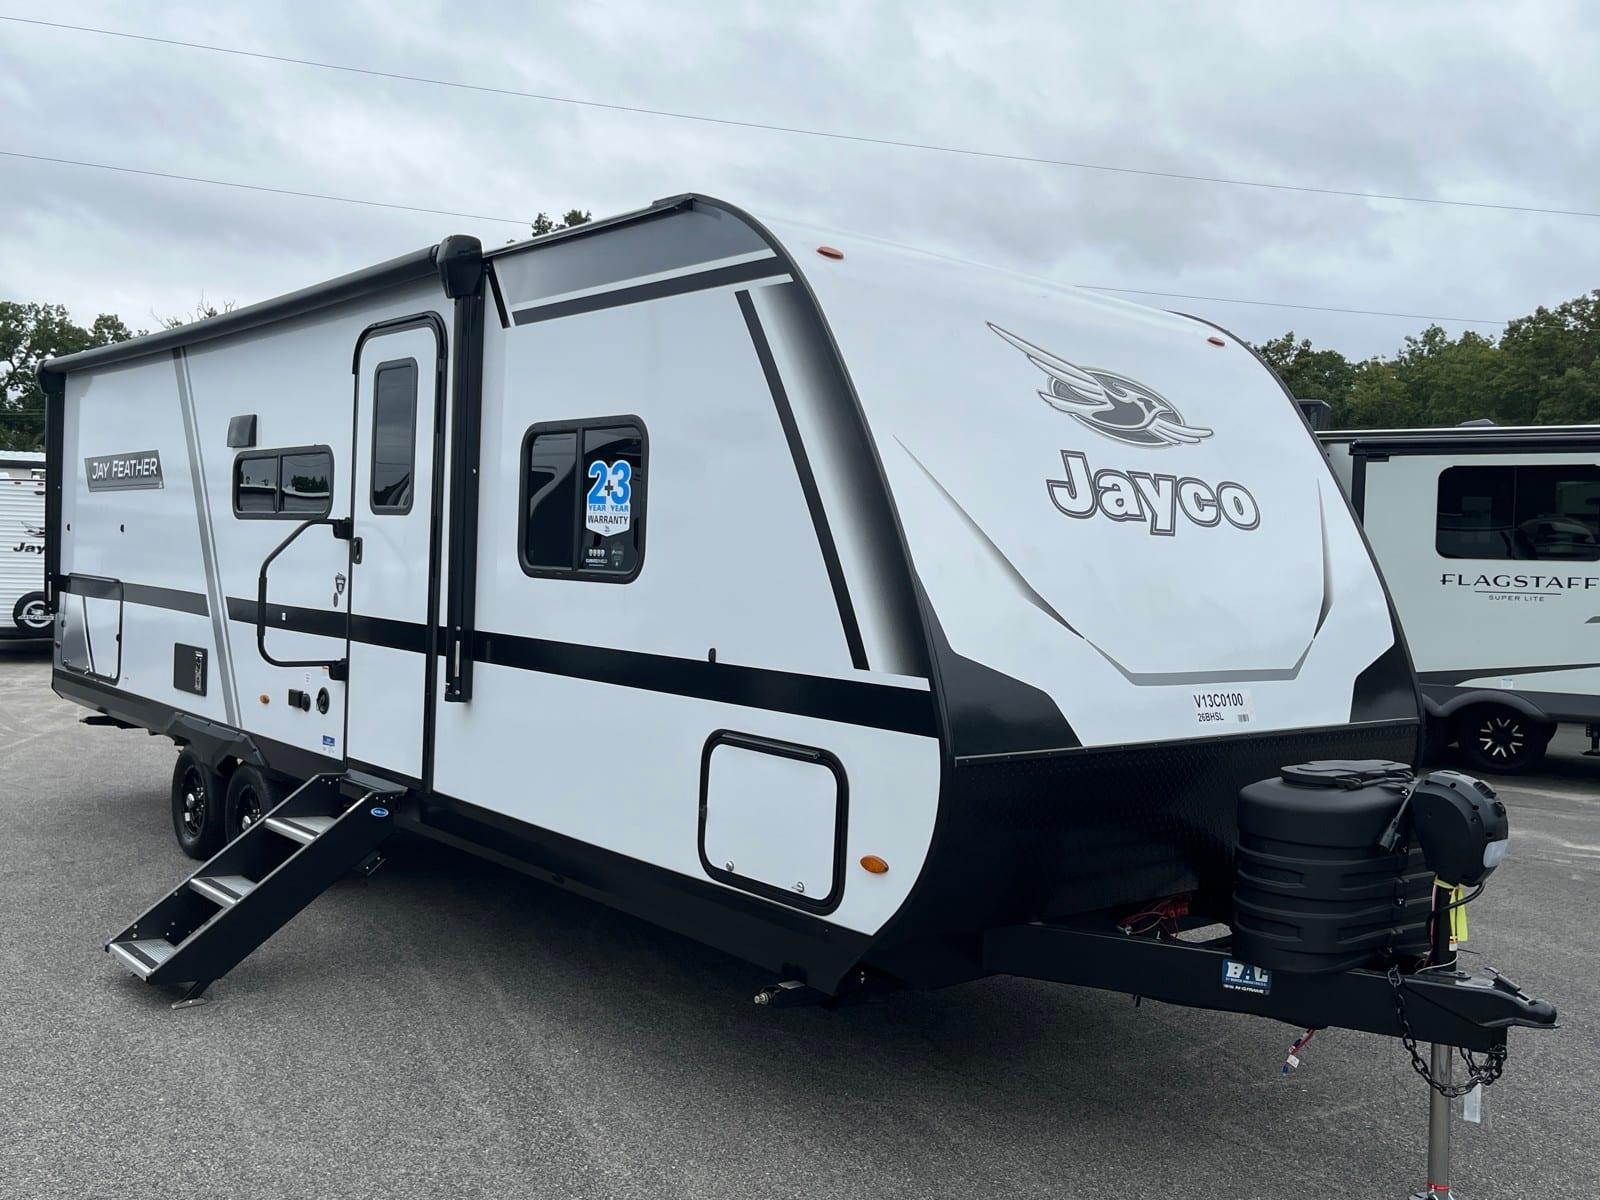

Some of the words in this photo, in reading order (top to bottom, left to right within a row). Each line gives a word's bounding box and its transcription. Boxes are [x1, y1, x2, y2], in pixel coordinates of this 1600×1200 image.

[92, 462, 110, 479] JAY
[112, 457, 158, 478] FEATHER
[1046, 449, 1261, 536] Jayco
[589, 504, 606, 512] YEAR
[611, 504, 629, 512] YEAR
[588, 514, 629, 525] WARRANTY
[1440, 573, 1599, 589] FLAGSTAFF
[1193, 693, 1243, 708] V13C0100
[1198, 712, 1224, 722] 26BHSL
